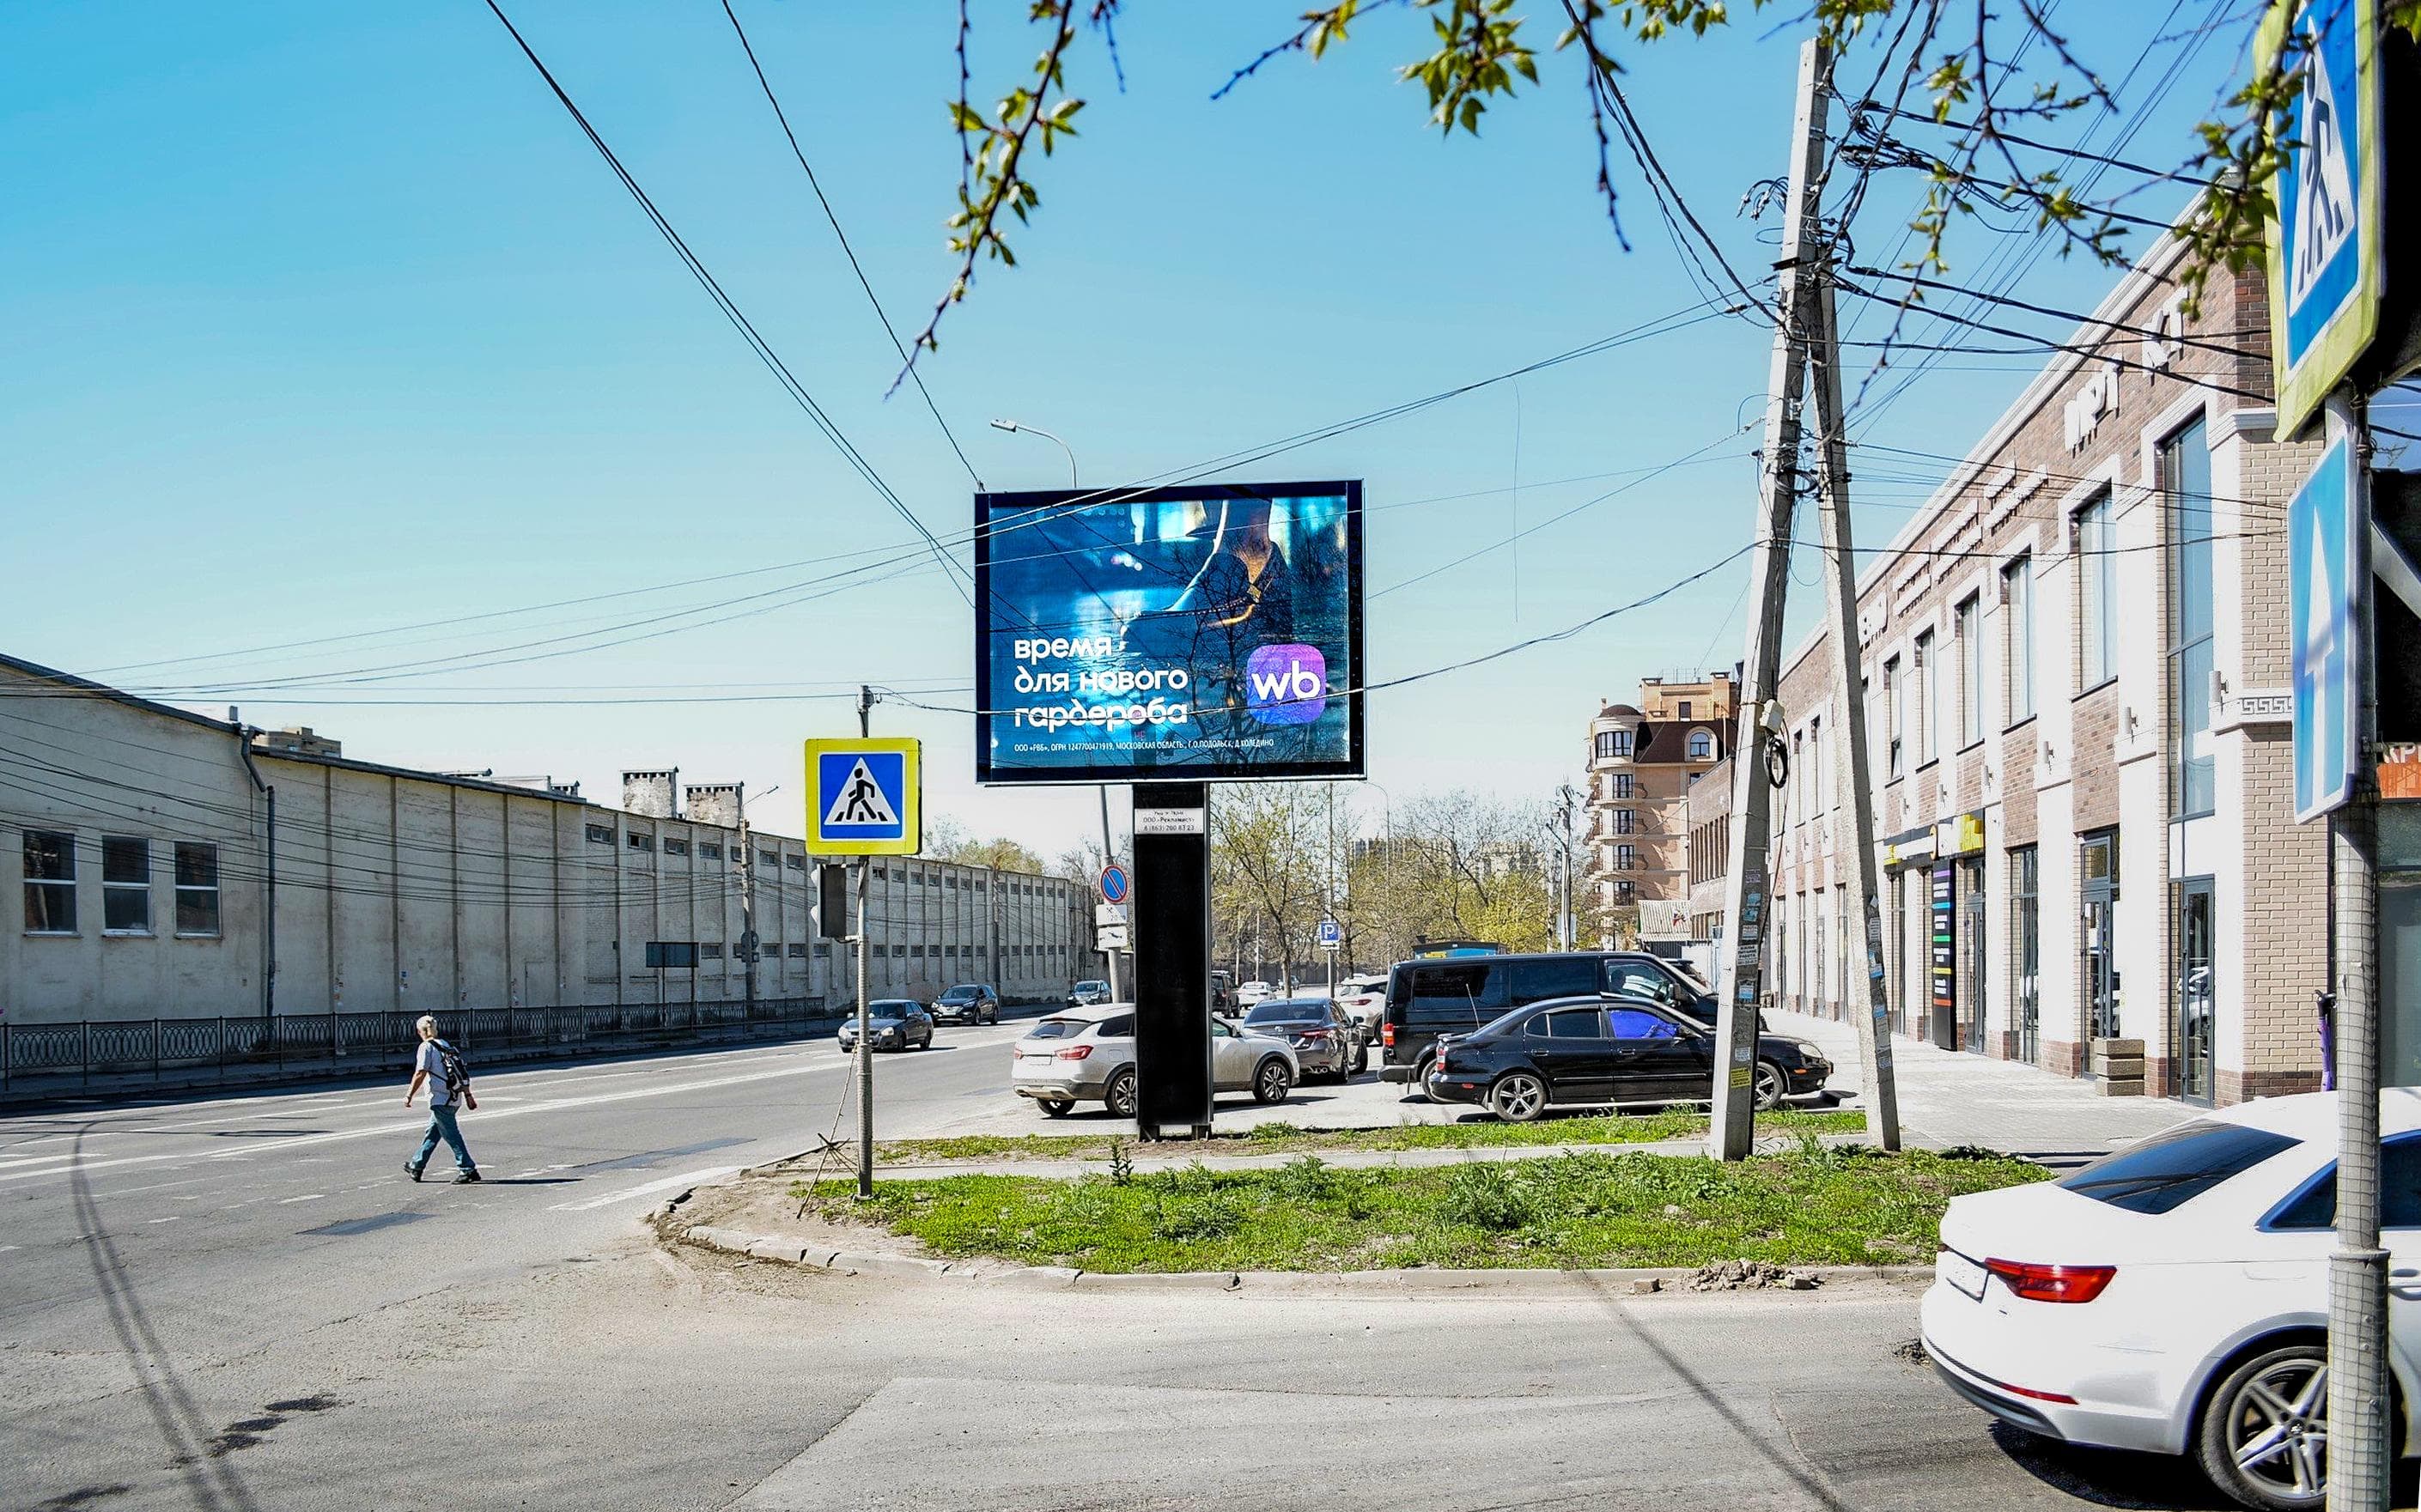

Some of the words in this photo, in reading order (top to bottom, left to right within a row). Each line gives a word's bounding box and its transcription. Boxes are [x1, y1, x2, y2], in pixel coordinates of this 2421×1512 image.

[1014, 636, 1112, 665] время
[1014, 665, 1069, 694] для
[1080, 669, 1189, 692] нового
[1251, 660, 1321, 701] wb
[1014, 696, 1188, 733] гардероба
[1014, 744, 1029, 752] ООО
